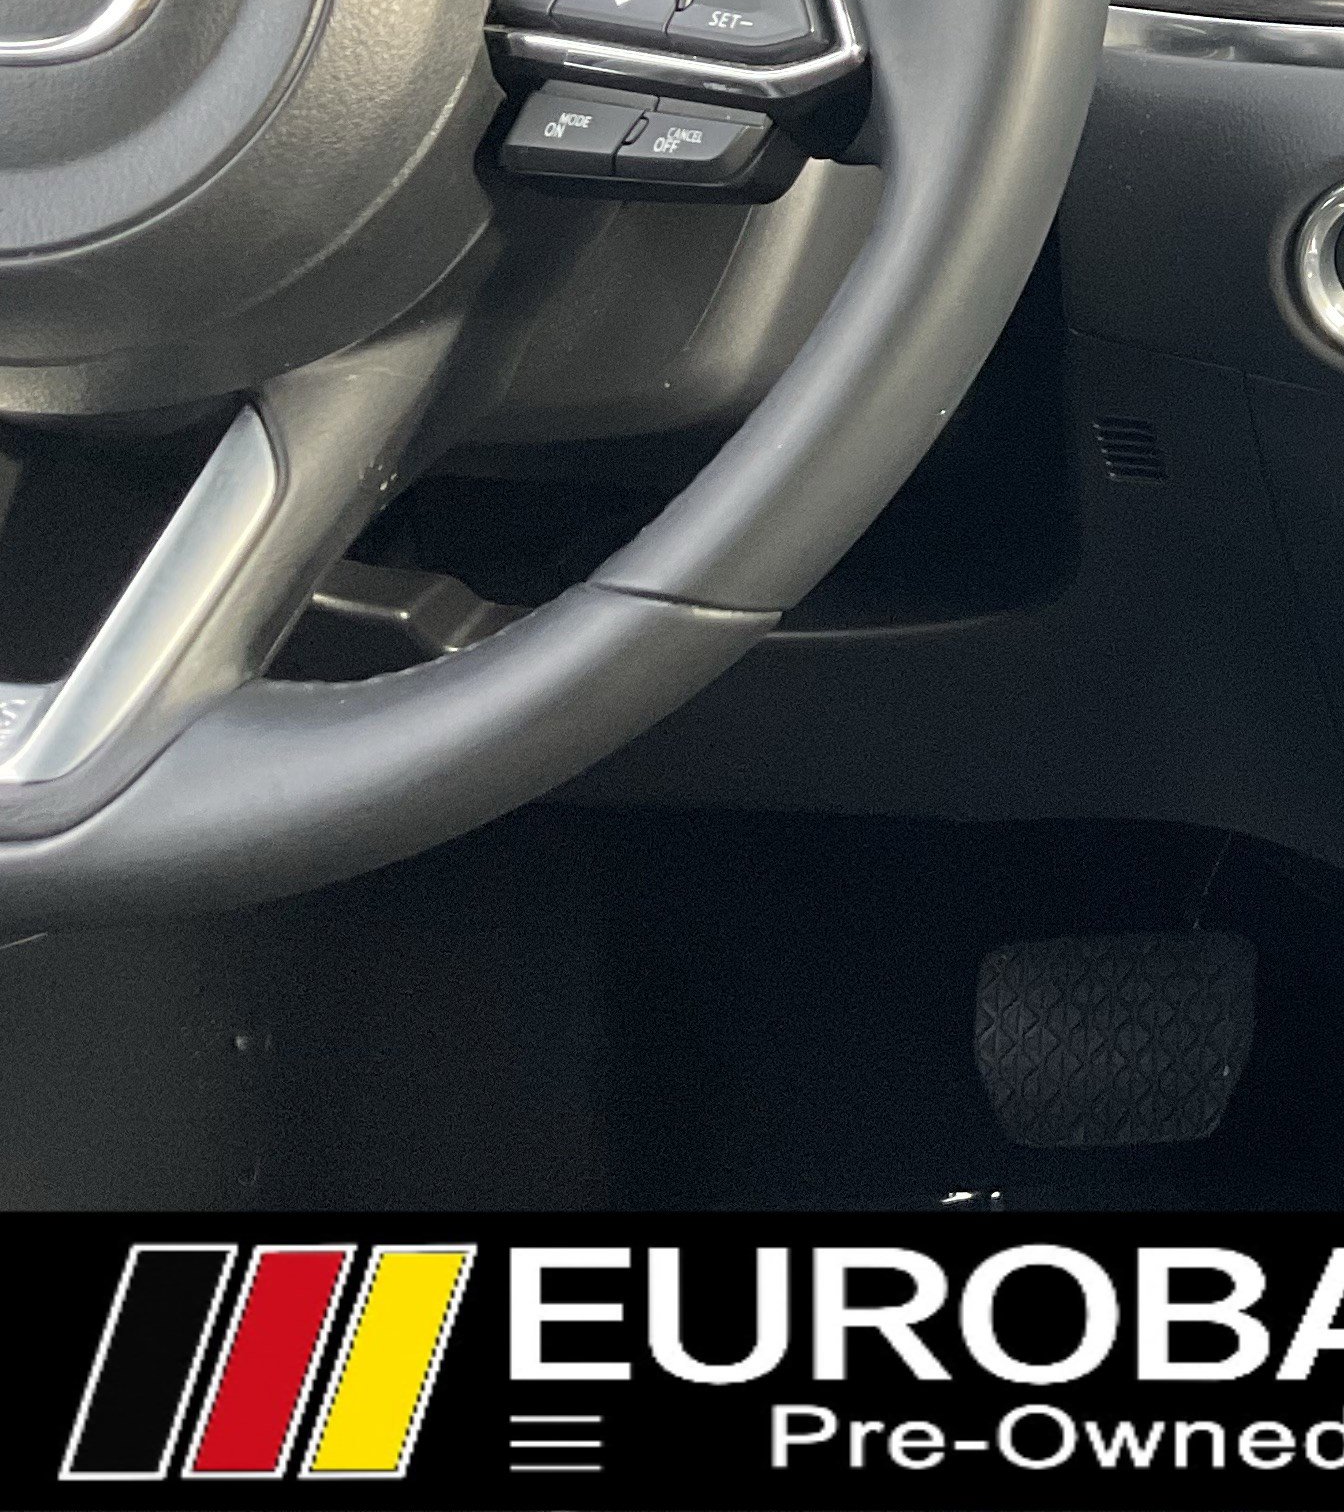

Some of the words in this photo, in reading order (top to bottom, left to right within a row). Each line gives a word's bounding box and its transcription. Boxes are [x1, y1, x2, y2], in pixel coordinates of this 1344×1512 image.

[558, 112, 593, 129] MODE
[543, 122, 566, 139] ON
[666, 126, 704, 144] CANCEL
[652, 136, 681, 154] OFF
